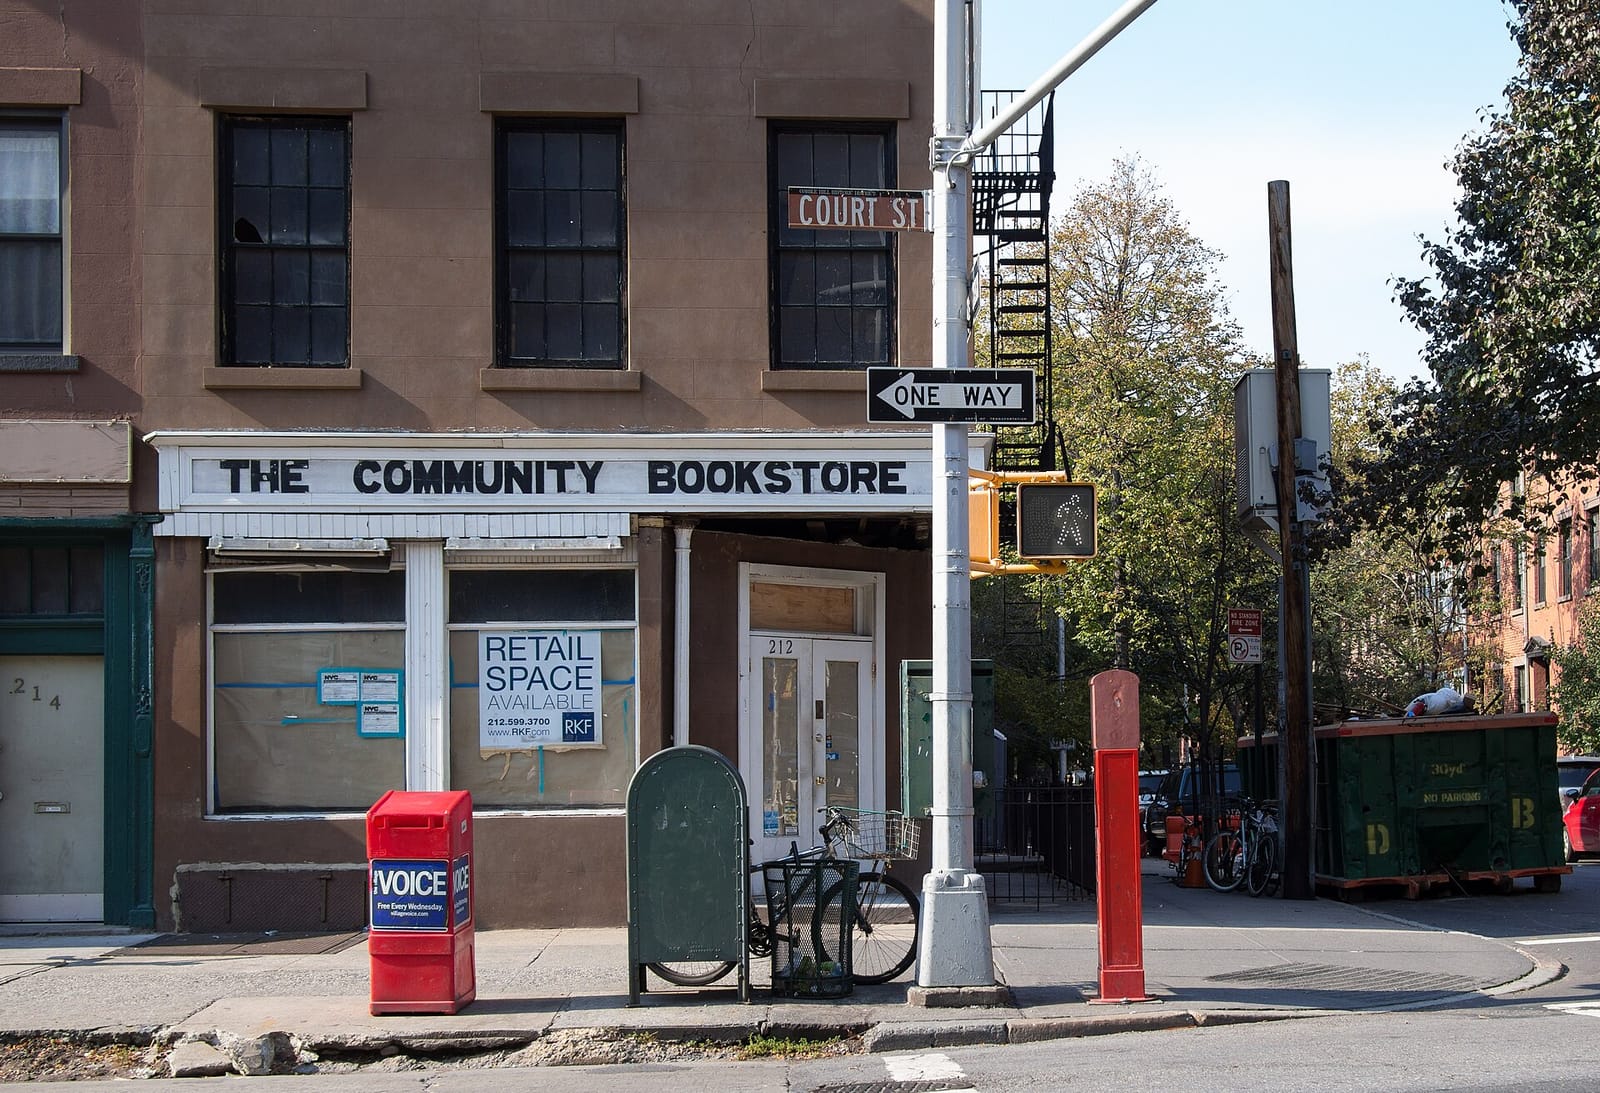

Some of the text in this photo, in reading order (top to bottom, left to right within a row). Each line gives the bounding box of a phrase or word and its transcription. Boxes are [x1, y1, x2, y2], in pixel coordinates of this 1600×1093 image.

[800, 195, 918, 228] COURT ST
[894, 385, 1012, 406] ONE WAY
[220, 459, 907, 494] THE COMMUNITY BOOKSTORE
[486, 636, 594, 661] RETAIL
[768, 639, 793, 654] 212
[486, 665, 593, 691] SPACE
[487, 694, 593, 710] AVAILABLE
[487, 718, 550, 726] 212.599.3700
[487, 728, 550, 736] www.RKF.com
[565, 719, 592, 735] RKF
[1423, 792, 1481, 802] NO PARKING
[1512, 798, 1535, 829] B
[1367, 824, 1390, 855] D
[378, 870, 447, 896] VOICE
[377, 902, 390, 910] Free
[391, 902, 408, 911] Every
